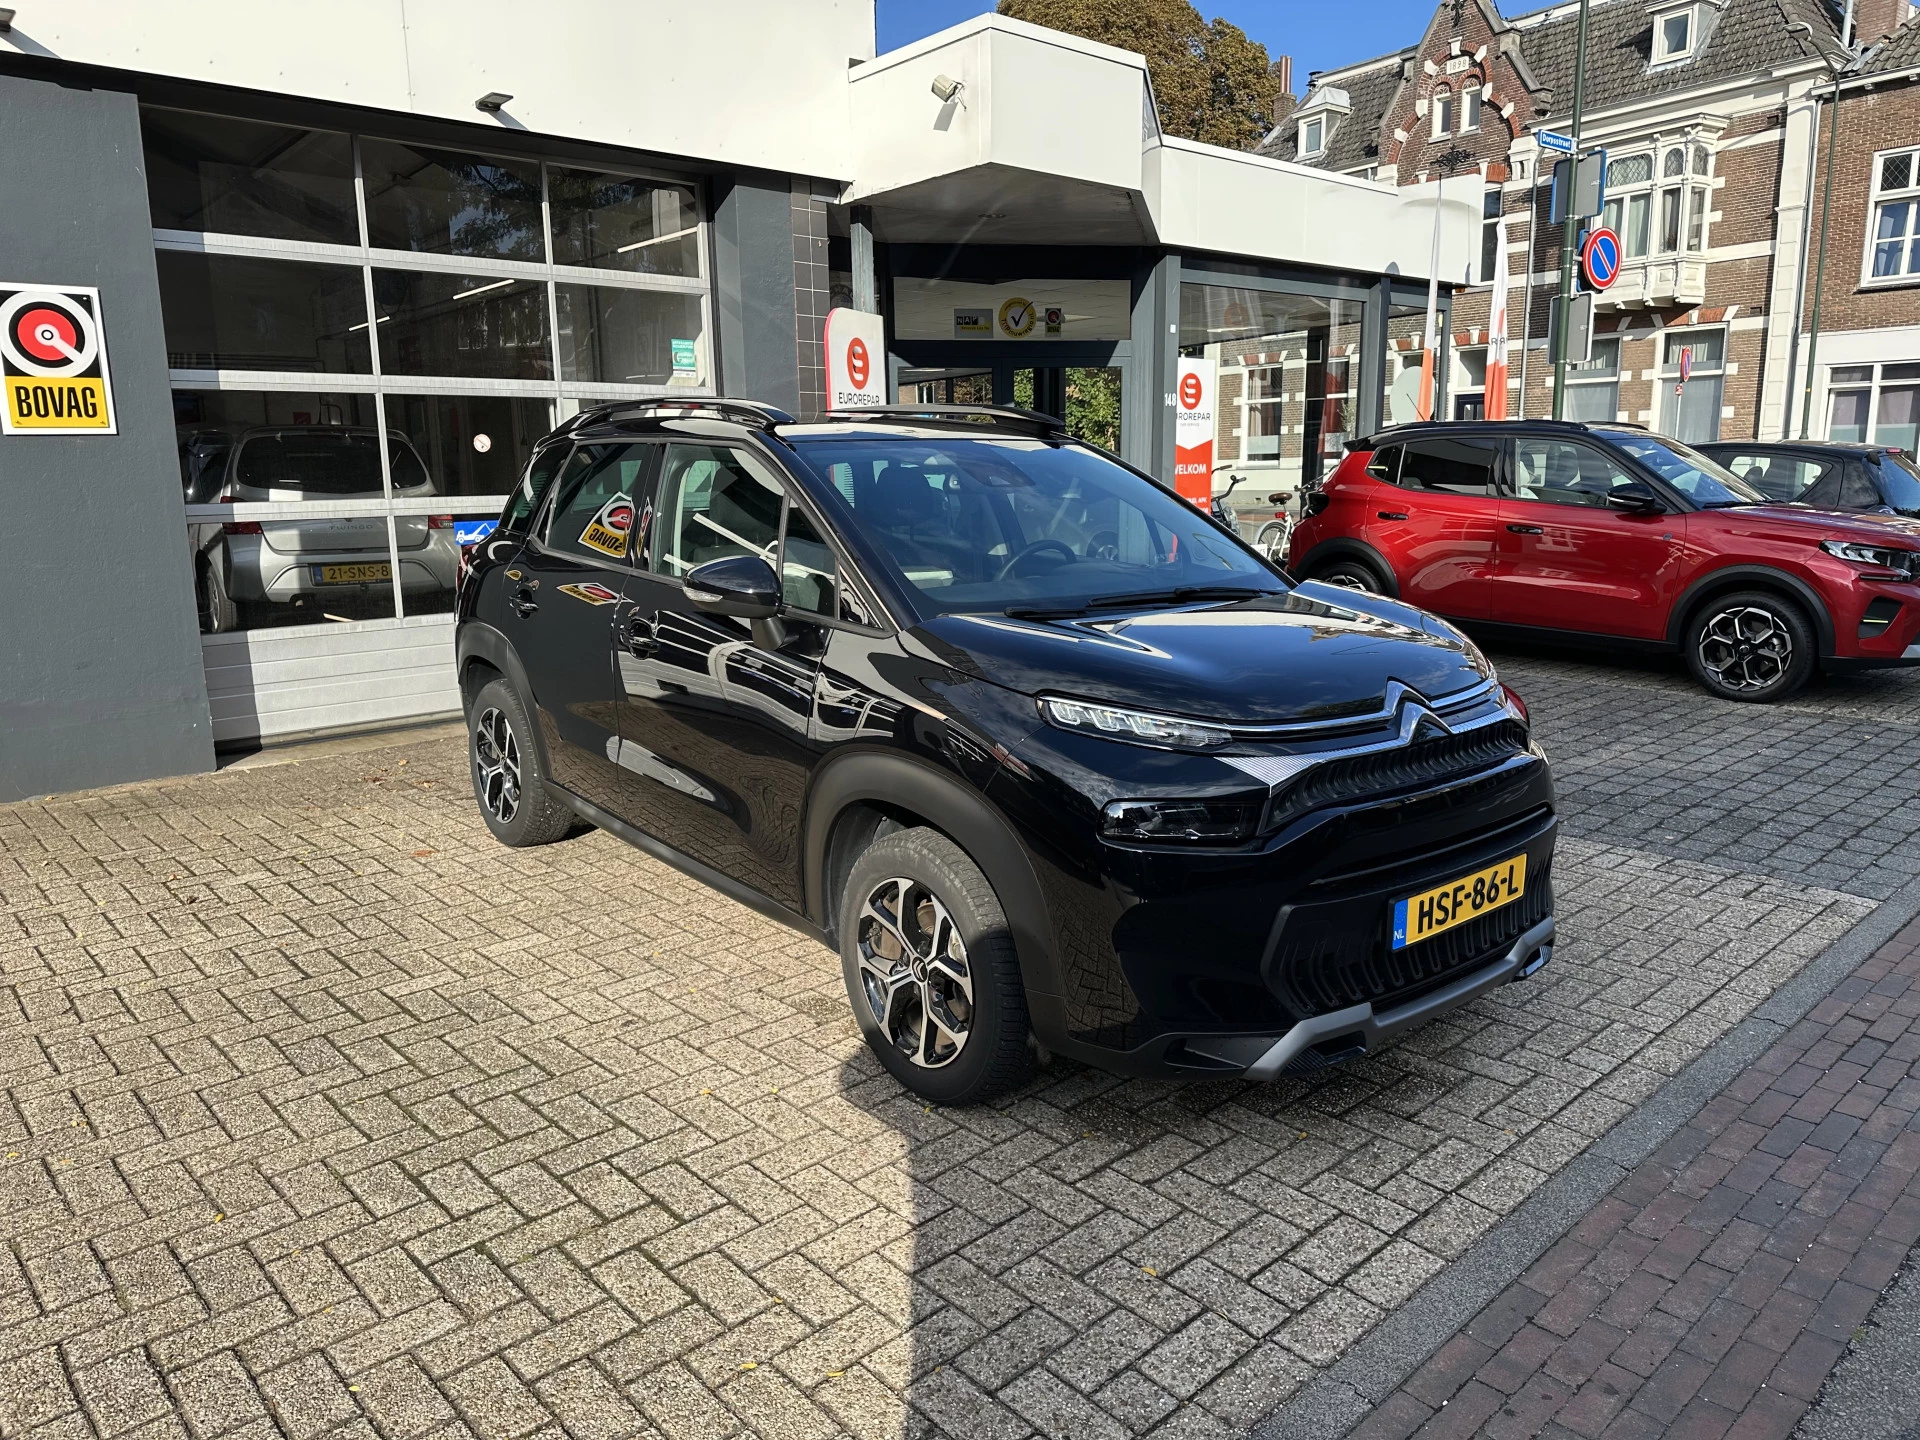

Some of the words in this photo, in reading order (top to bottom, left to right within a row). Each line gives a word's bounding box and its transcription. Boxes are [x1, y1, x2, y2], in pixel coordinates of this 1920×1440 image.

[1542, 133, 1571, 149] Dorpsstraat
[14, 385, 98, 419] BOVAG
[838, 392, 880, 407] EUROREPAR
[1164, 392, 1177, 407] 148
[328, 565, 389, 580] 21-SNS-8
[1417, 864, 1519, 934] HSF-86-L
[1393, 928, 1405, 941] NL
